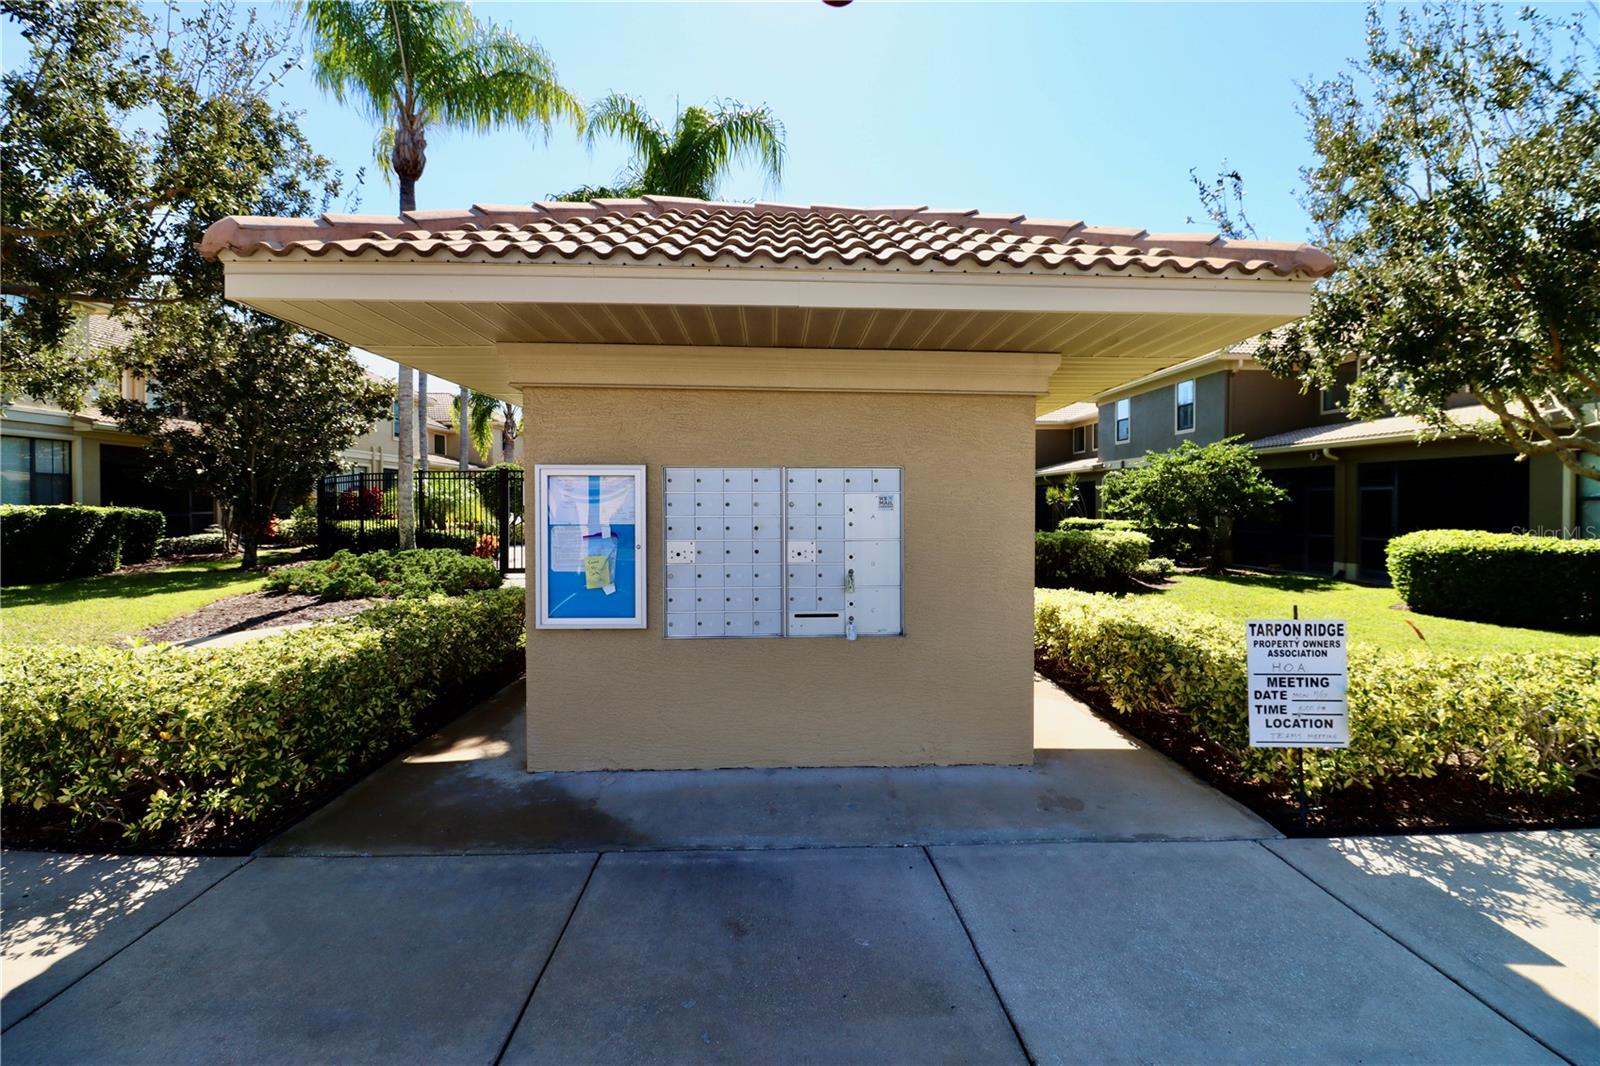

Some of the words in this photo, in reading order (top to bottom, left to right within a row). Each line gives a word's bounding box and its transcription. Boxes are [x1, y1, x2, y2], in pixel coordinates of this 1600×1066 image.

[1249, 623, 1301, 636] TARPON
[1305, 623, 1344, 636] RIDGE
[1253, 640, 1300, 648] PROPERTY
[1303, 640, 1341, 648] OWNERS
[1267, 649, 1328, 657] ASSOCIATION
[1267, 677, 1330, 688] MEETING
[1254, 690, 1288, 700] DATE
[1254, 705, 1288, 715] TIME
[1265, 719, 1334, 729] LOCATION
